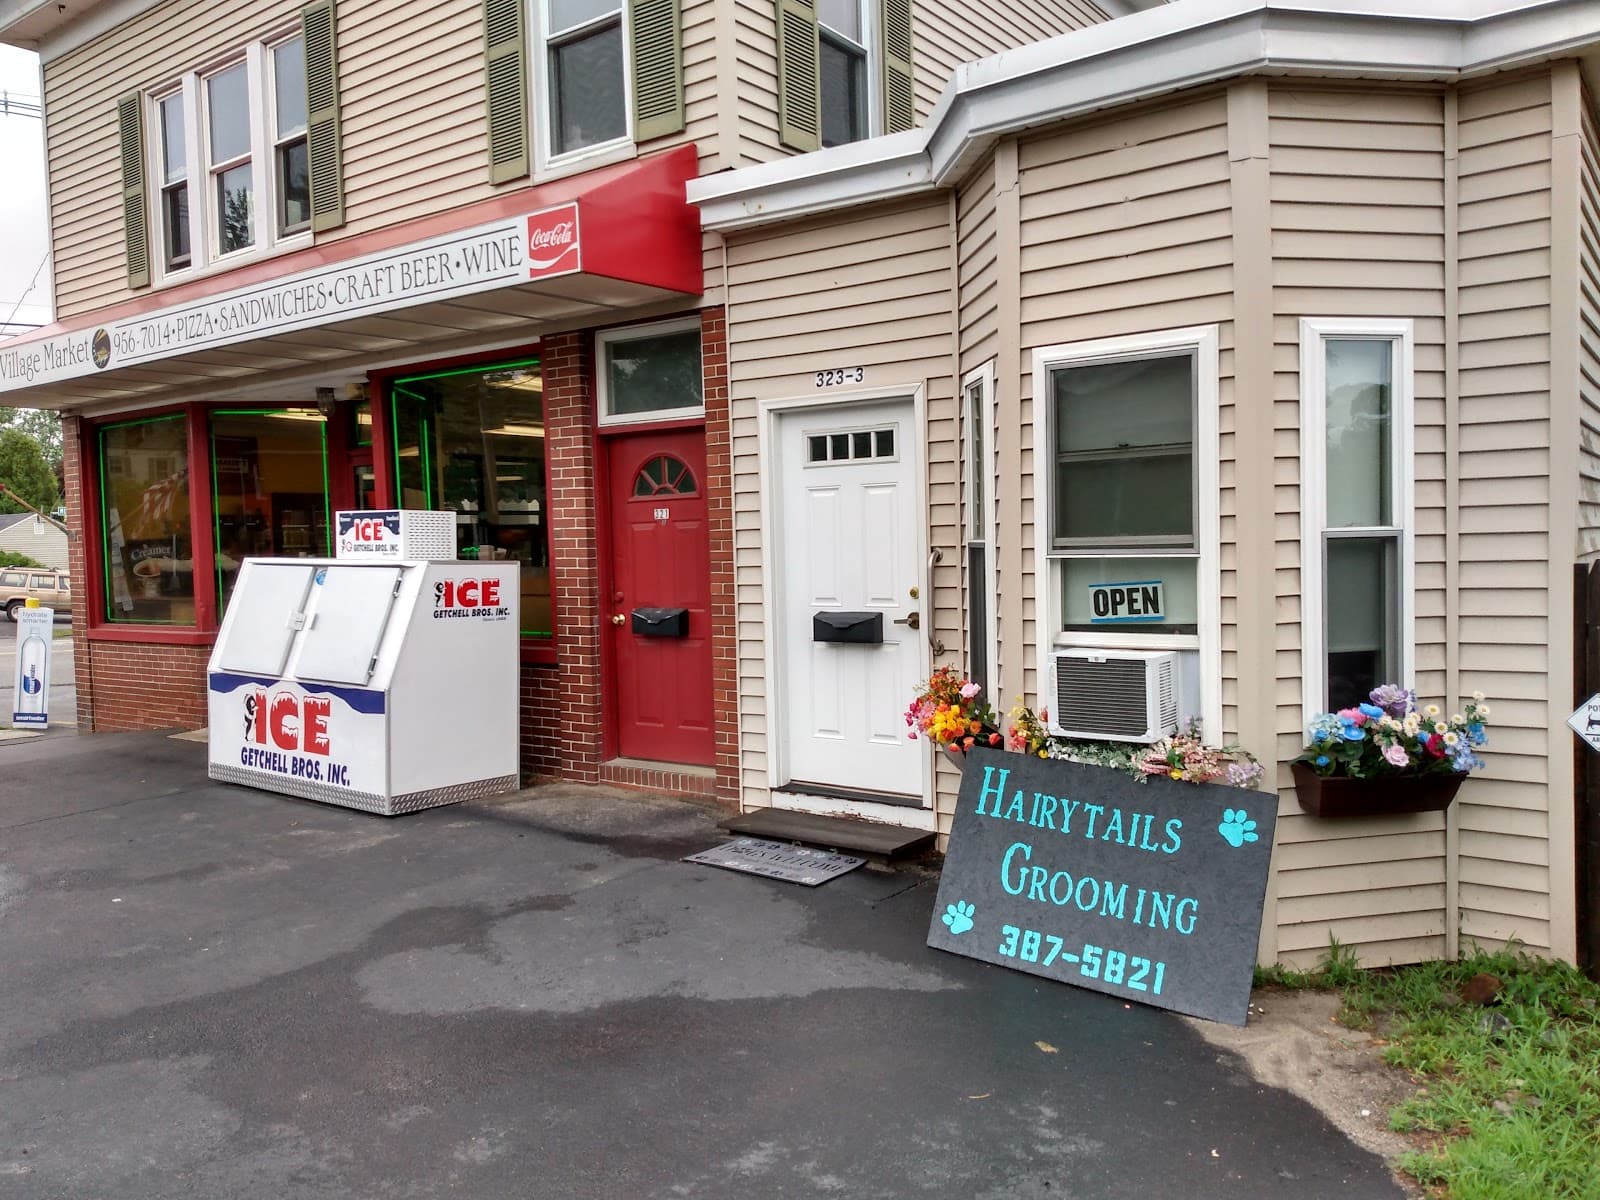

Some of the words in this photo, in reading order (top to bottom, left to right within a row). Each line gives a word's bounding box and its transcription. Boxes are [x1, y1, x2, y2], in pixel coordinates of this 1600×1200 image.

[531, 221, 574, 250] Coca-Cola
[0, 351, 41, 382] Village
[43, 337, 90, 371] Market
[815, 367, 864, 388] 323-3
[654, 508, 668, 519] 321
[354, 520, 384, 541] ICE
[443, 578, 500, 608] ICE
[1093, 586, 1160, 617] OPEN
[433, 608, 470, 619] GETCHELL
[471, 607, 494, 617] BROS.
[495, 607, 511, 617] INC.
[255, 688, 331, 756] ICE
[241, 746, 288, 774] GETCHELL
[291, 756, 323, 781] BROS.
[327, 763, 351, 787] INC.
[975, 766, 1183, 854] HAIRYTAILS
[1000, 842, 1199, 935] GROOMING
[999, 924, 1166, 995] 387-5821
